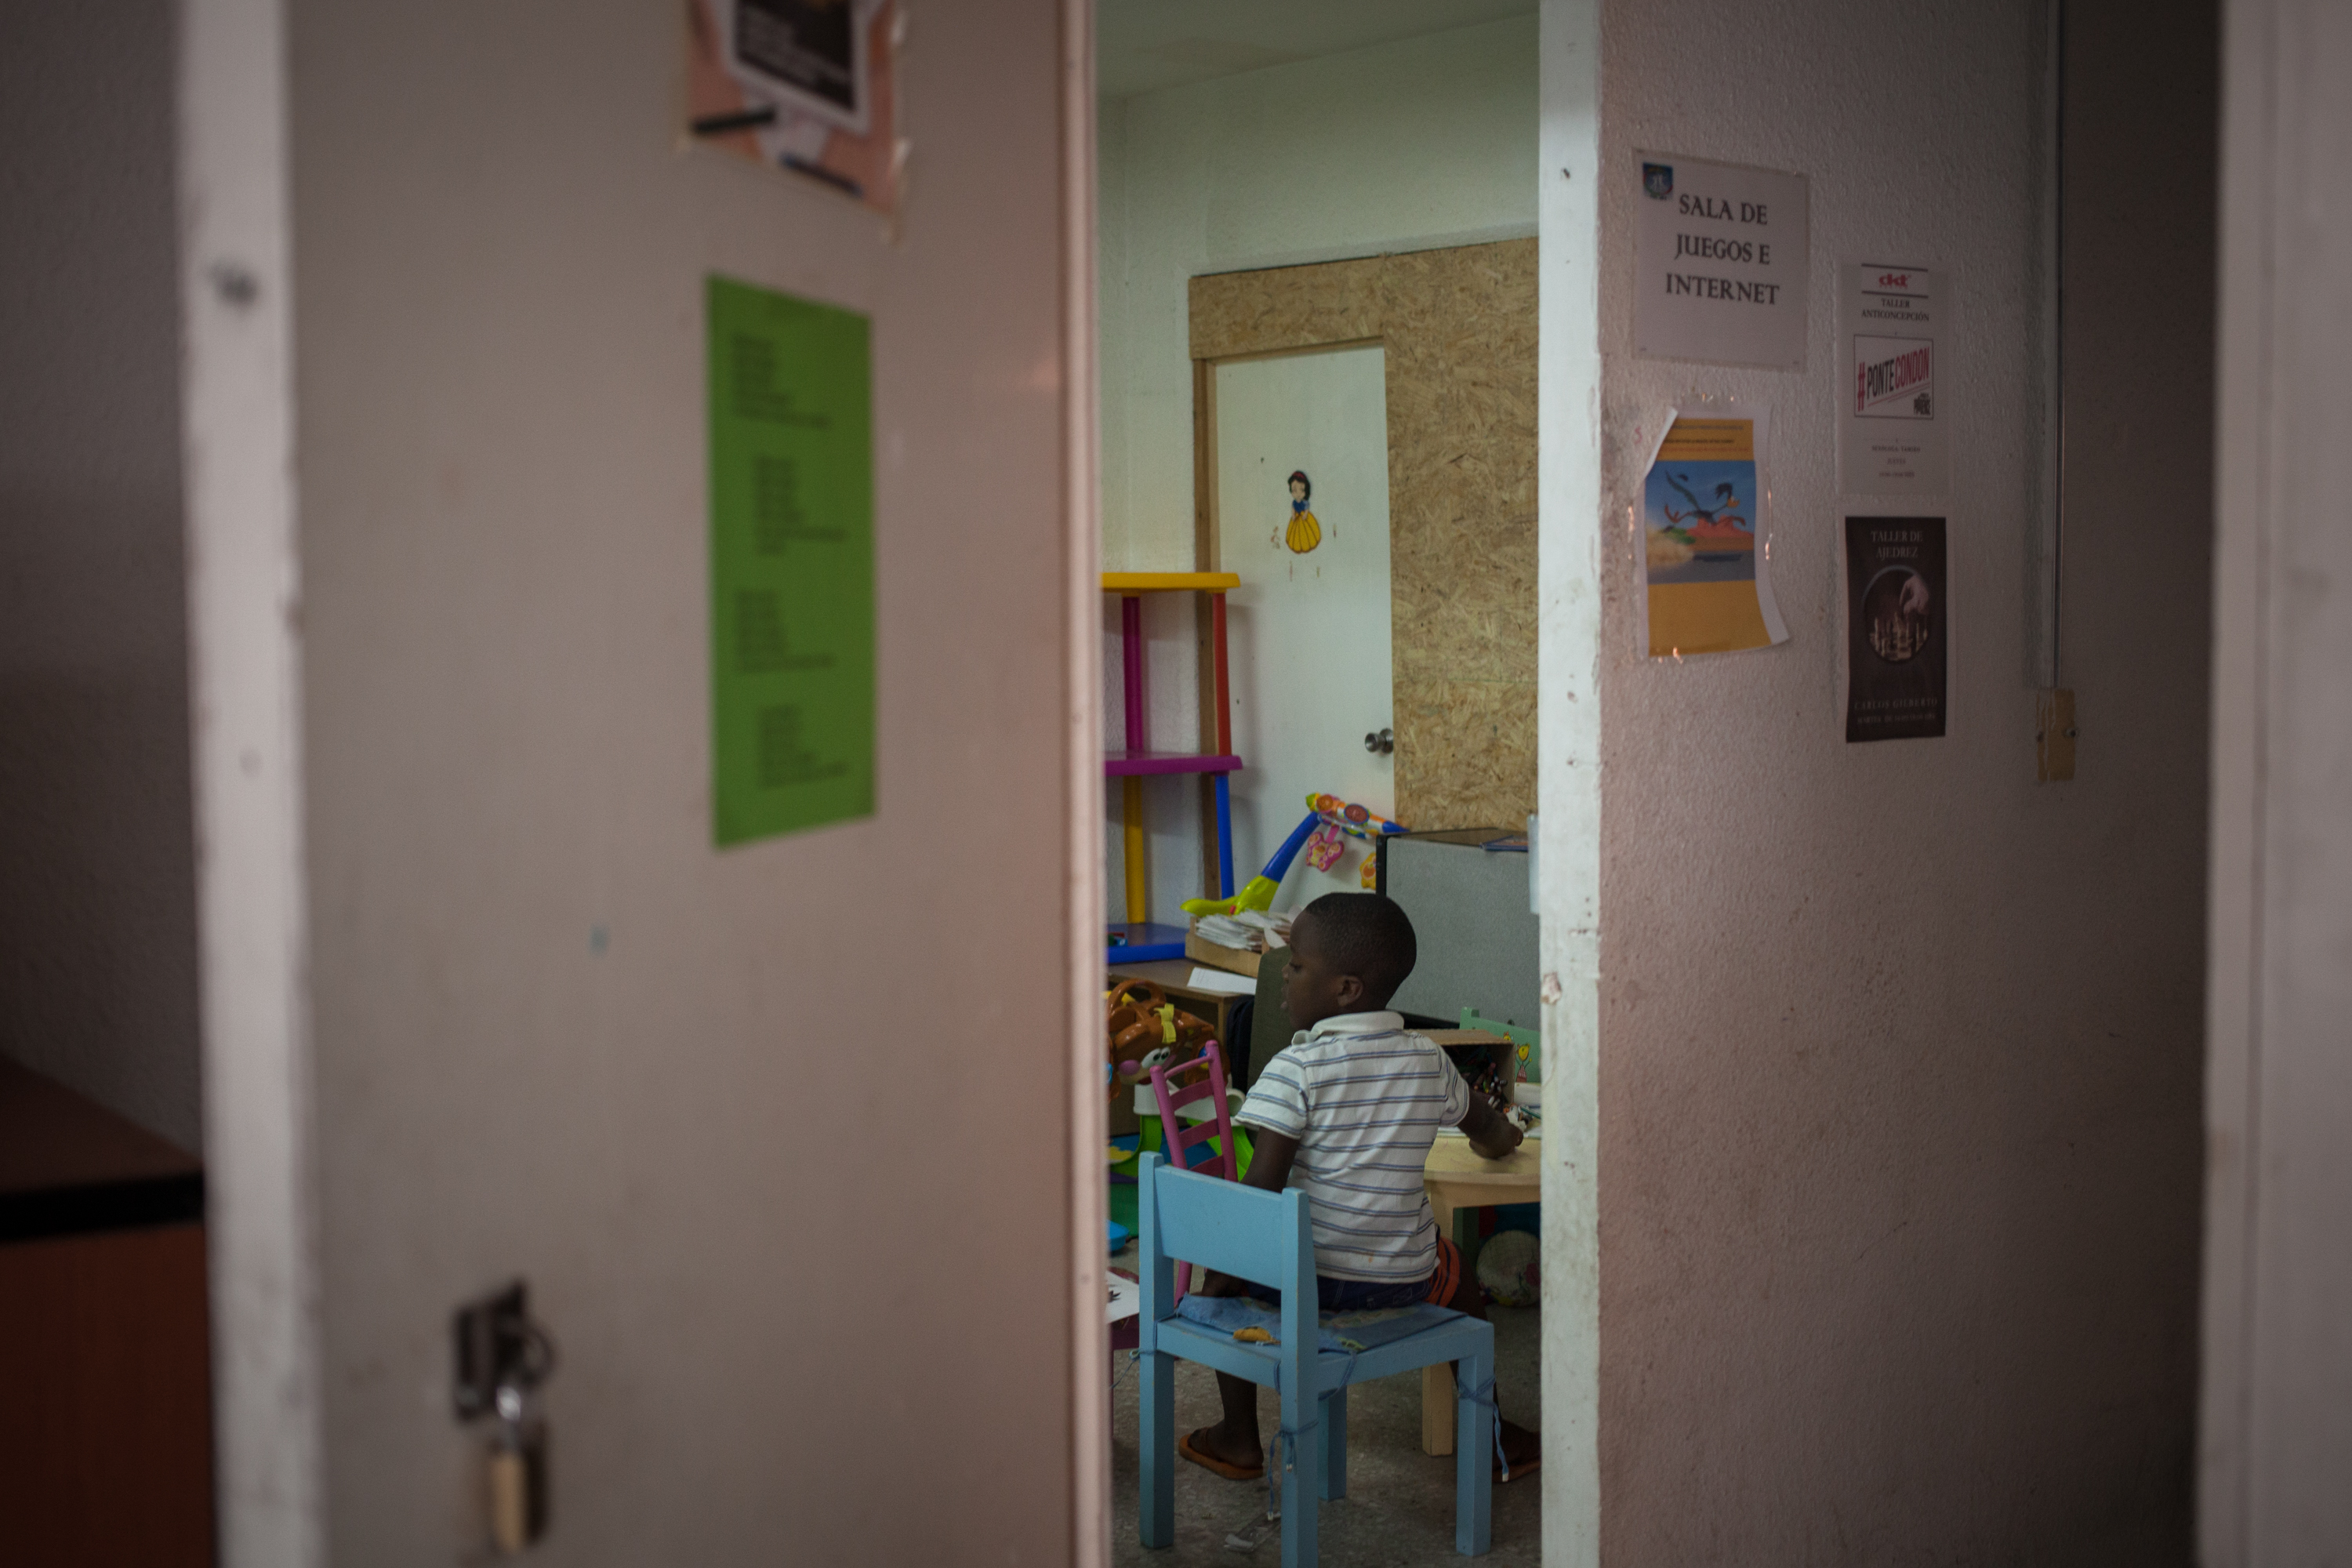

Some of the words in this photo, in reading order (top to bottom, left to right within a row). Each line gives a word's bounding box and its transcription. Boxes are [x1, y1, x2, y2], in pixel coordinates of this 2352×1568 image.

[1679, 193, 1733, 221] SALA
[1740, 201, 1769, 226] DE
[1674, 233, 1753, 263] JUEGOS
[1758, 243, 1771, 265] E
[1665, 272, 1780, 305] INTERNET
[1881, 298, 1911, 309] TALLER
[1861, 309, 1930, 322] ANTICONCEPCIÓN
[1871, 531, 1907, 542] TALLER
[1910, 531, 1923, 542] DE
[1875, 546, 1918, 561] AJEDREZ
[1853, 699, 1890, 710] CARLOS
[1893, 697, 1938, 709] GILBERTO
